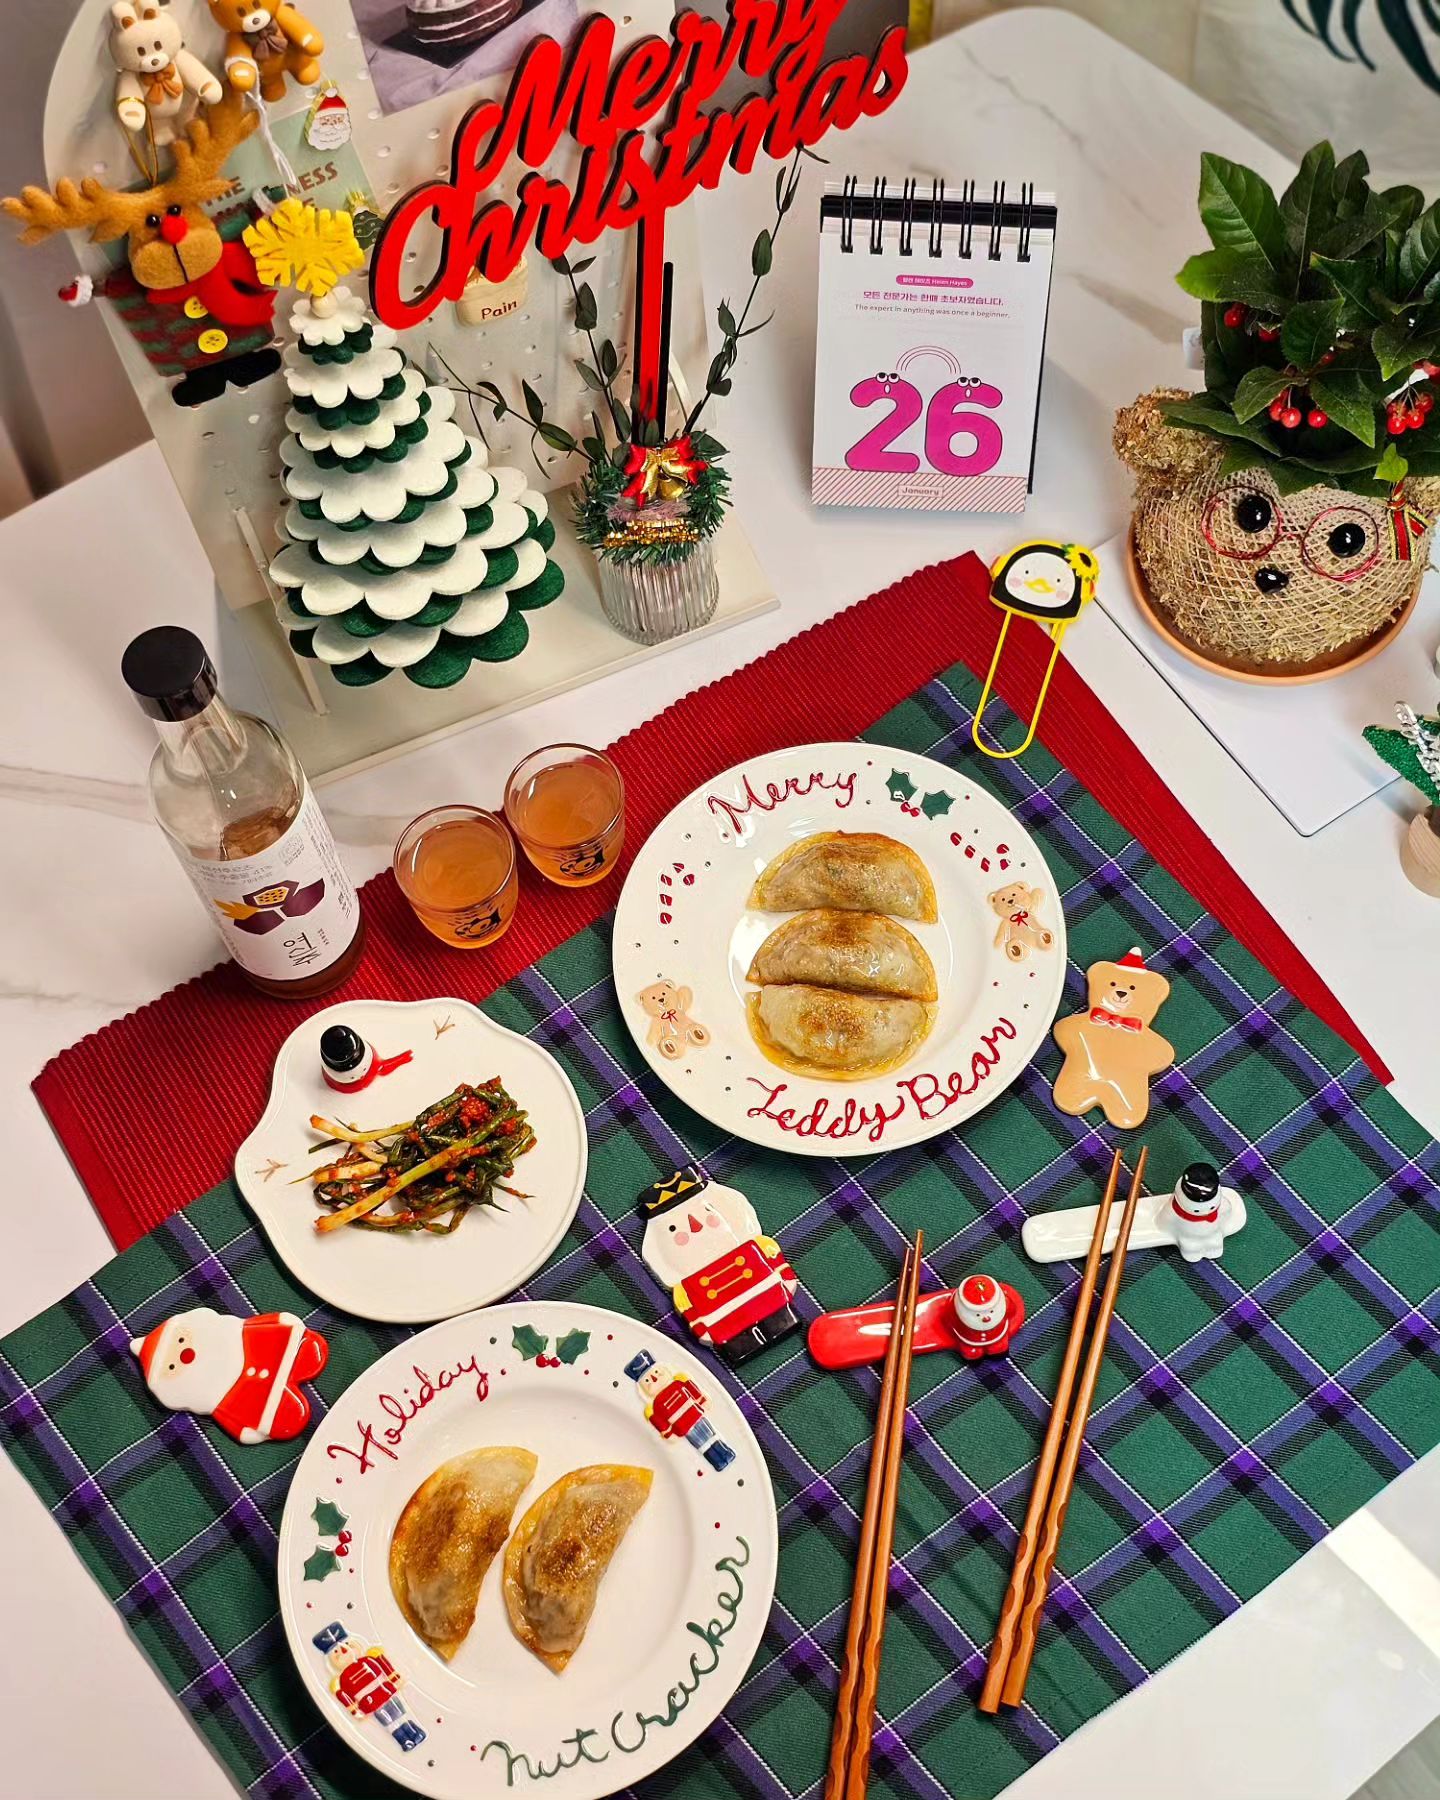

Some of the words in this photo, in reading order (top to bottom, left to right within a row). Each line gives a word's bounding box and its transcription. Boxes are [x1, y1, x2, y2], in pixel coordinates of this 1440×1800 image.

[482, 0, 848, 168] Merry
[369, 24, 909, 330] Christmas
[481, 300, 517, 320] Pain
[863, 291, 881, 299] 모든
[883, 292, 918, 301] 전문가는
[869, 305, 893, 313] expert
[903, 306, 935, 315] anything
[976, 310, 1011, 319] beginner.
[845, 373, 1003, 477] 26
[902, 486, 939, 496] January
[707, 766, 861, 833] Merry
[746, 1077, 905, 1143] Teddy
[898, 1016, 1018, 1121] Bear
[327, 1354, 490, 1475] Holiday
[611, 1536, 750, 1753] Cracker
